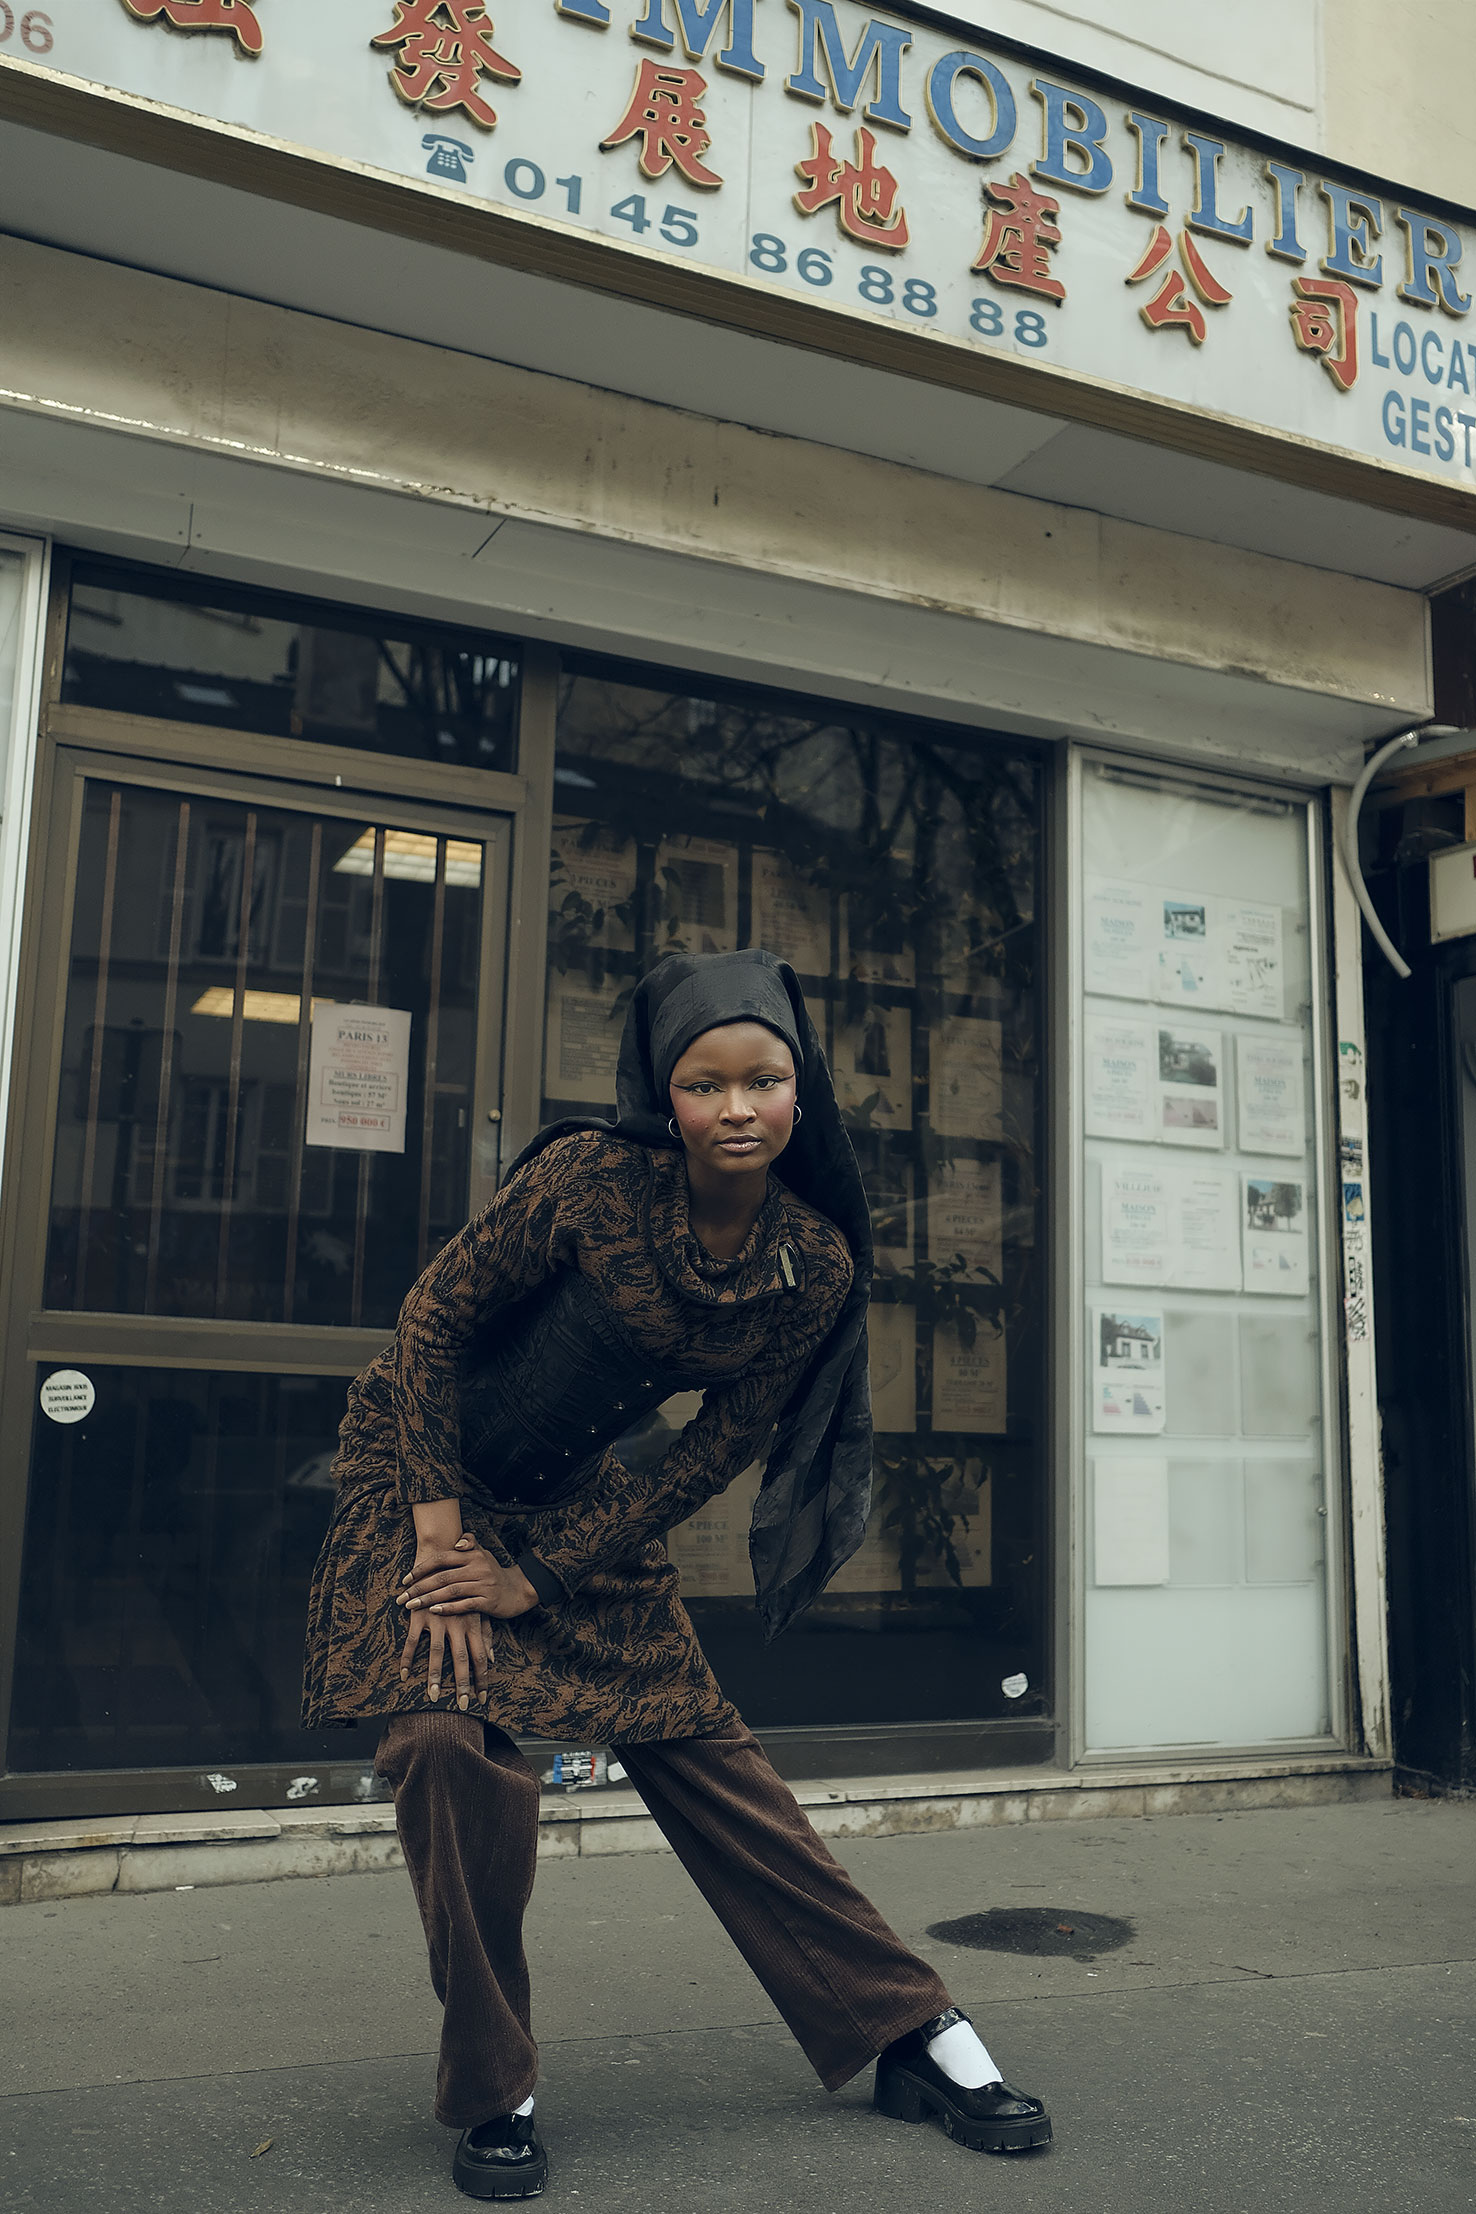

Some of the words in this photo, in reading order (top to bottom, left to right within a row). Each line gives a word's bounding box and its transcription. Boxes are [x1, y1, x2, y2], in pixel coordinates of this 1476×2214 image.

[554, 0, 1473, 316] MMOBILIER
[504, 157, 582, 215] 01
[610, 194, 699, 247] 45
[750, 233, 833, 287] 86
[858, 265, 938, 317] 88
[969, 298, 1048, 347] 88
[1370, 311, 1476, 395] LOCA
[338, 1030, 373, 1041] PARIS
[377, 1034, 388, 1043] 13
